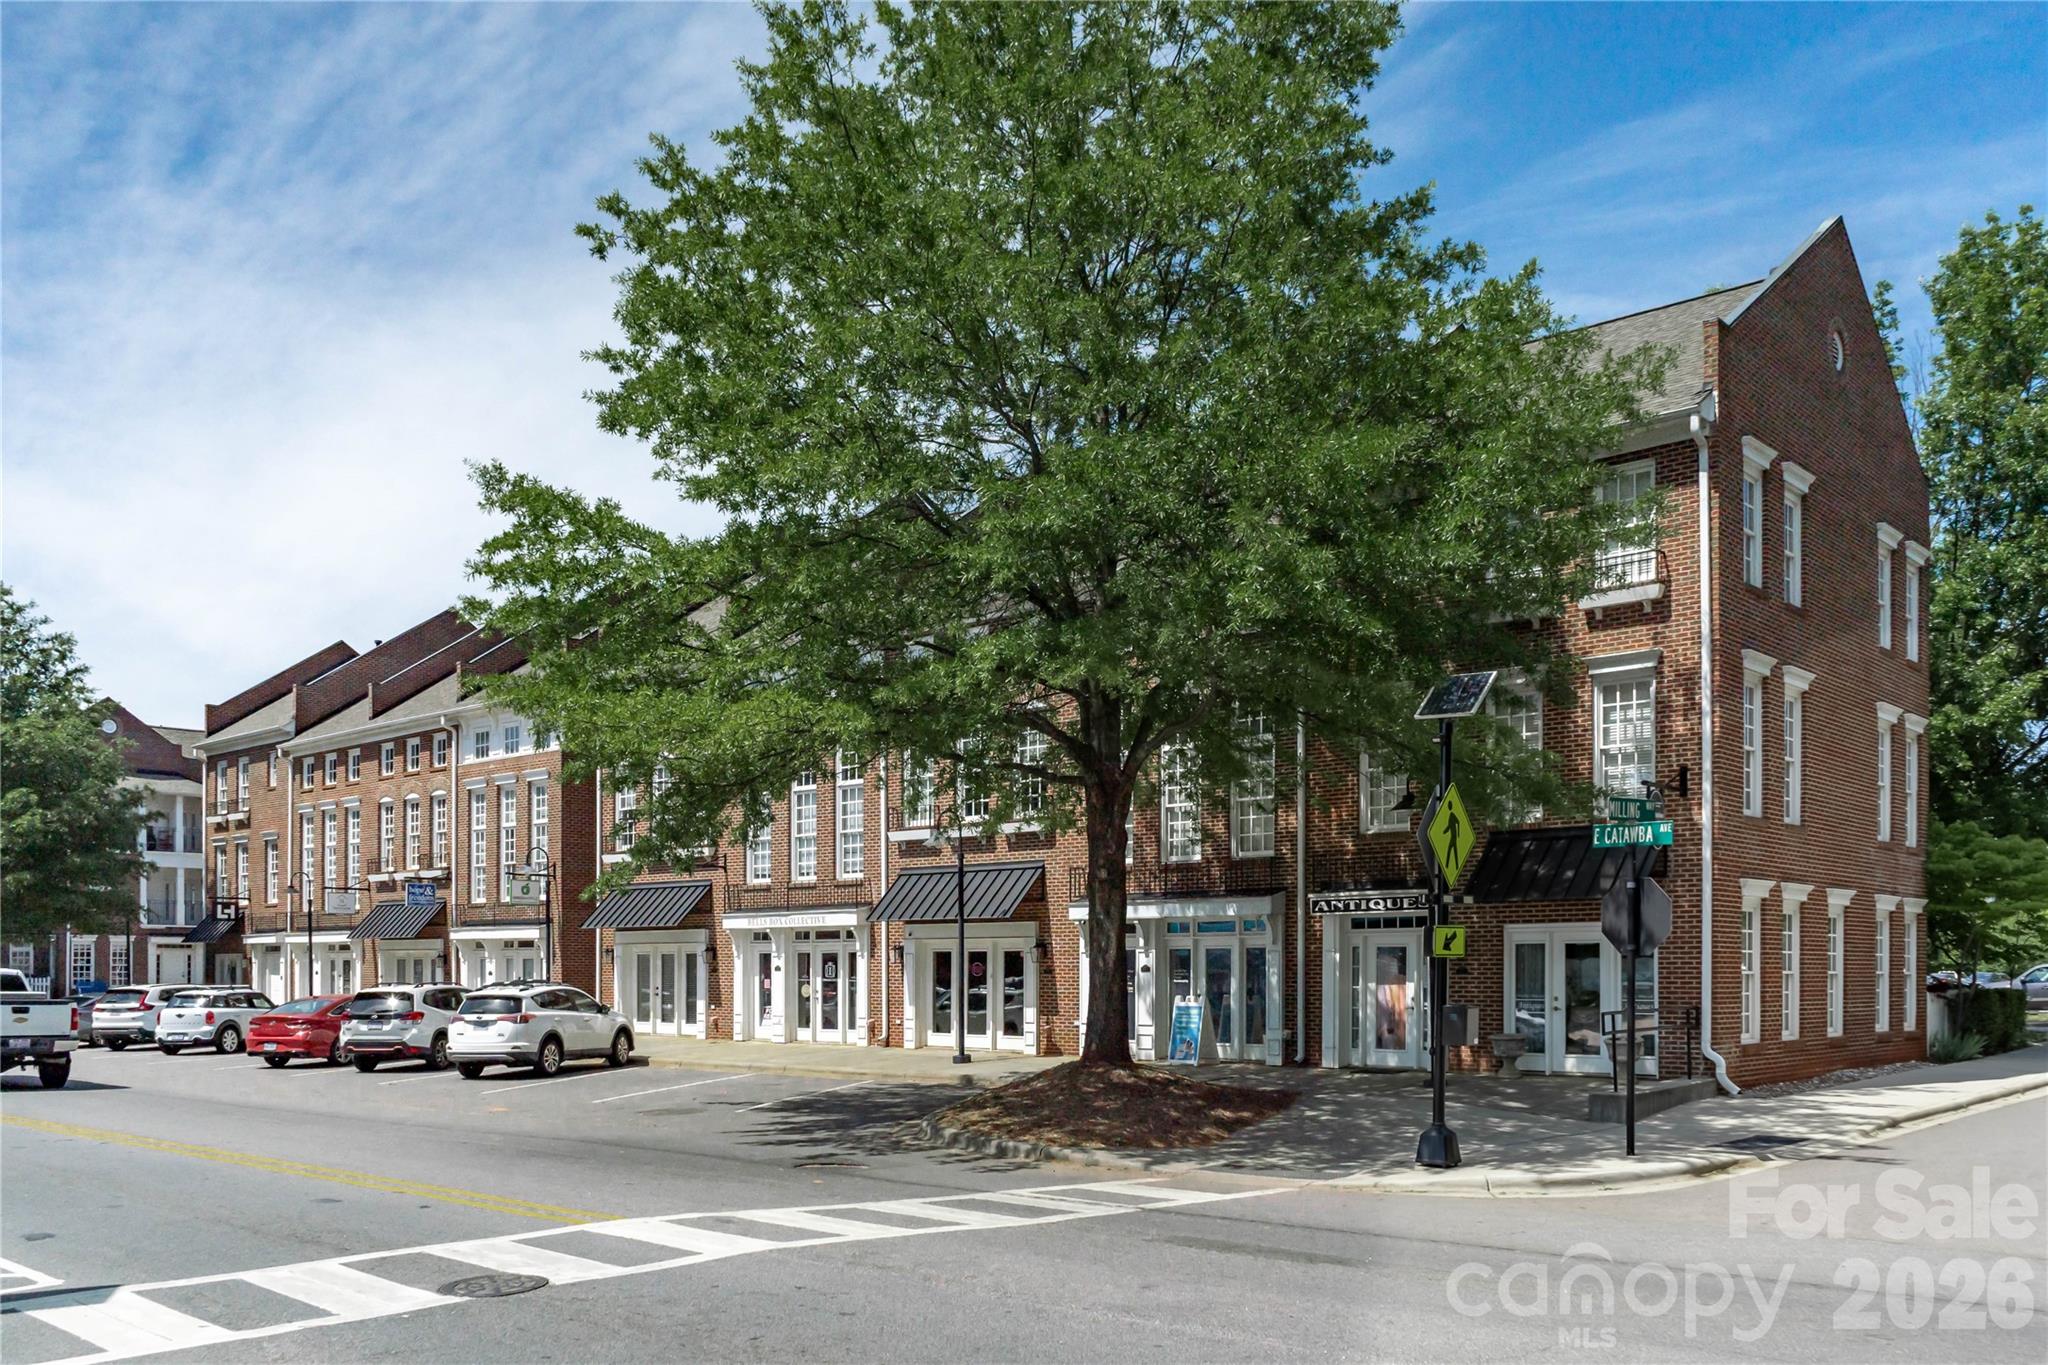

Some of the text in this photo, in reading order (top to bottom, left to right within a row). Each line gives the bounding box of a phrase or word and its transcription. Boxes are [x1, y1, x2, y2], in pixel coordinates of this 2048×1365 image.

[1609, 801, 1640, 818] MILLING
[1594, 823, 1672, 844] E CATAWBA AVE
